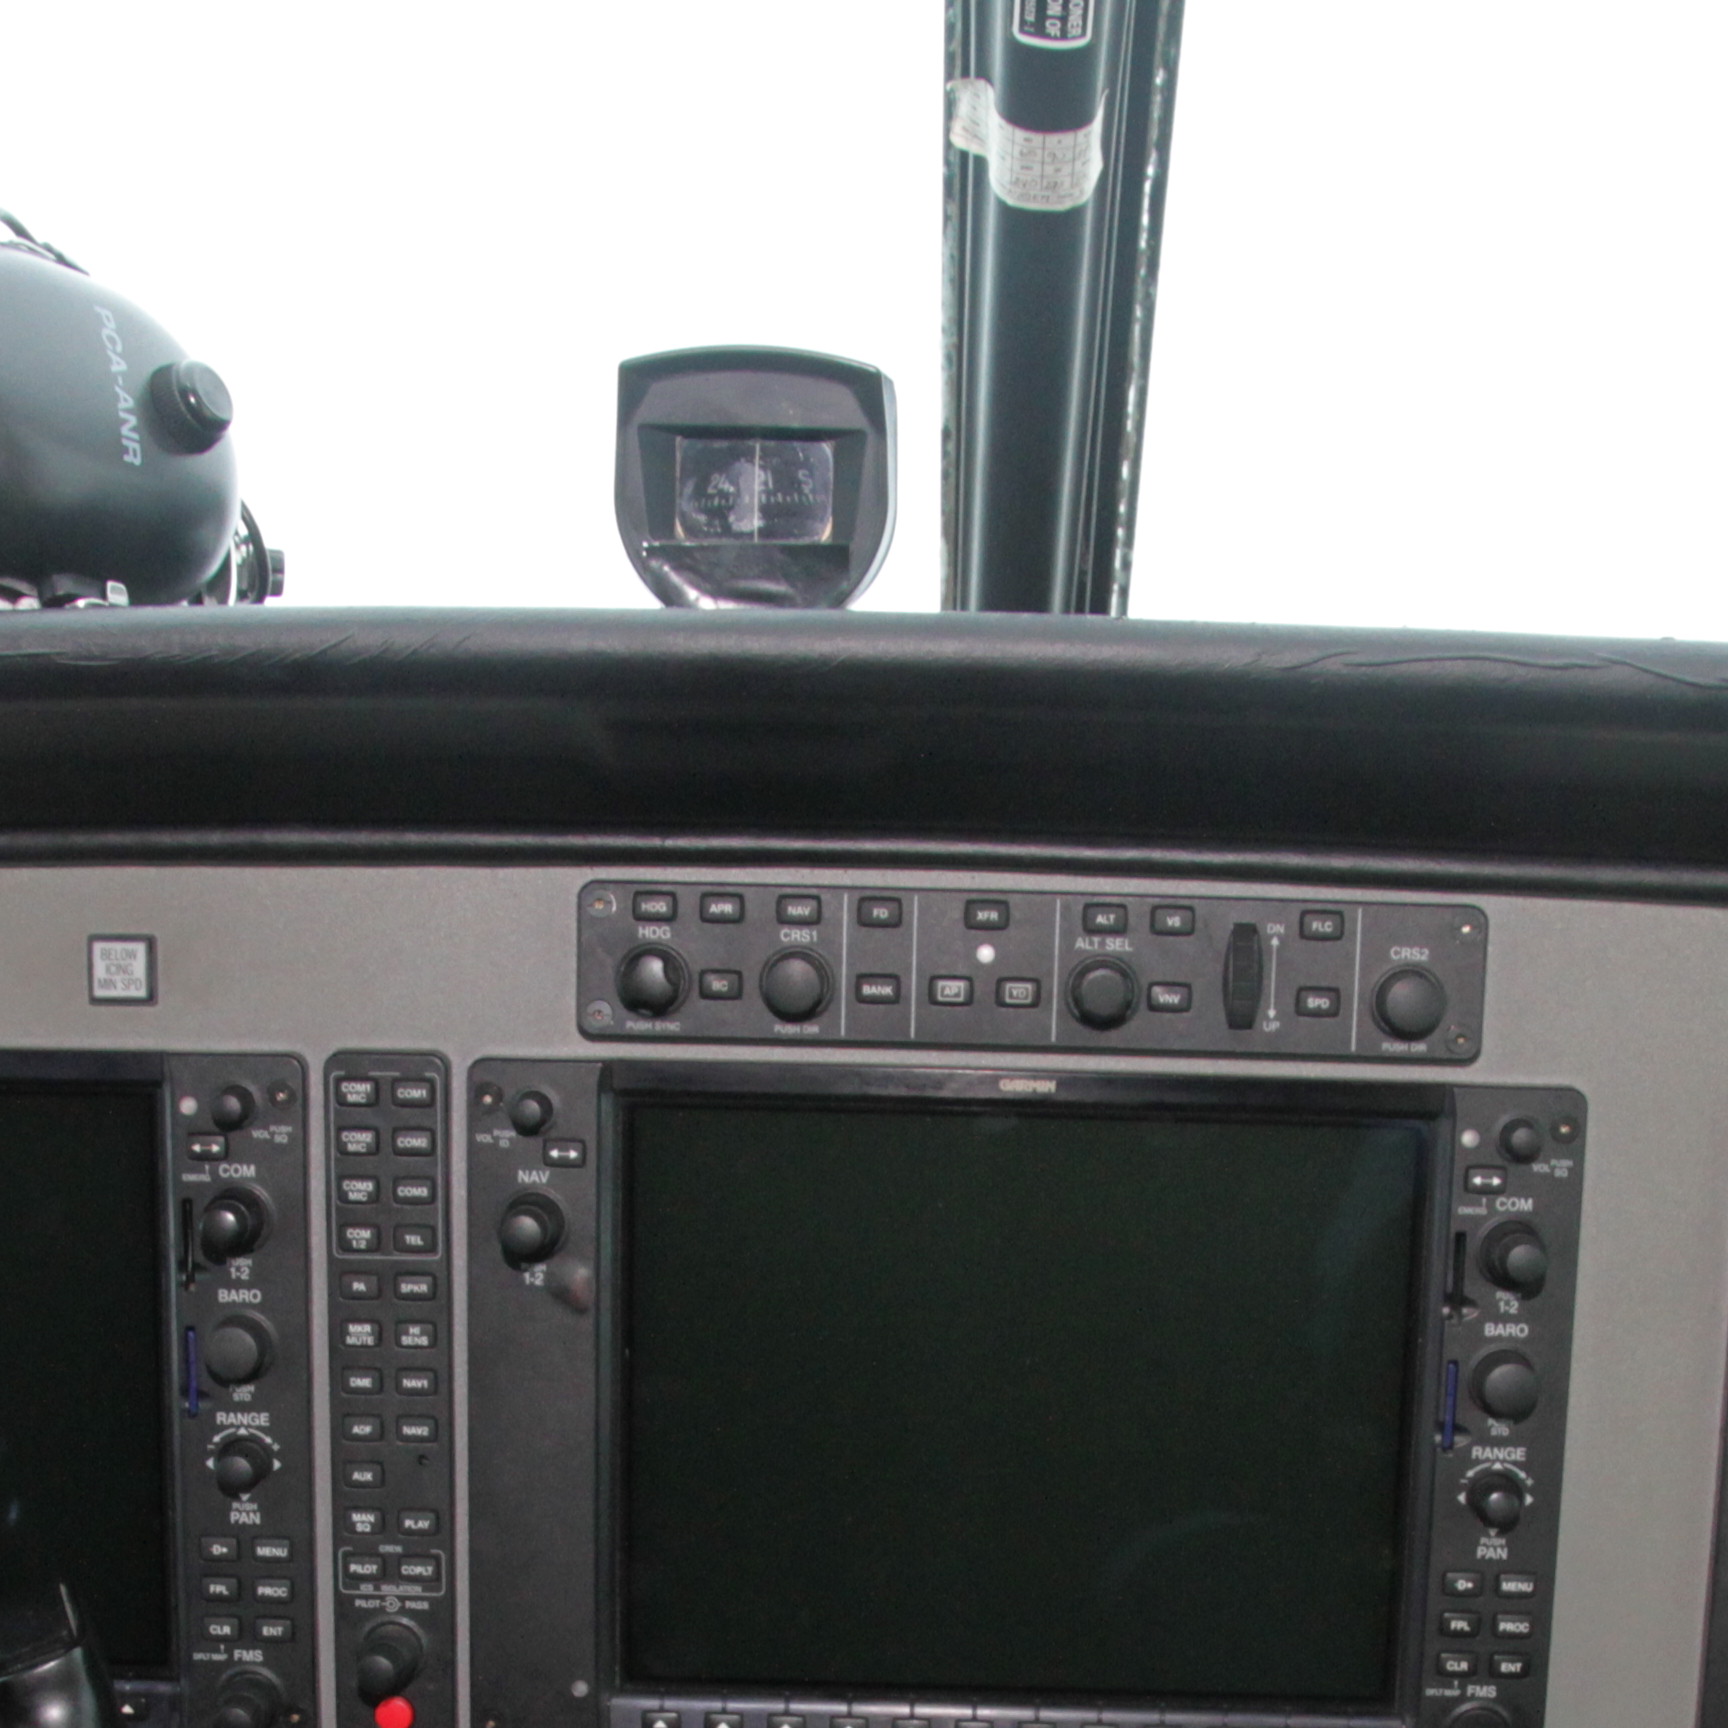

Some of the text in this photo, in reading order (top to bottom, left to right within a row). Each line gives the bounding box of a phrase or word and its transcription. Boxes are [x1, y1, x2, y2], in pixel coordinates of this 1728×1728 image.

[94, 305, 142, 466] PCA-ANR
[638, 926, 670, 939] HDG
[1267, 923, 1284, 934] DN
[781, 929, 817, 942] CRS1
[1075, 937, 1133, 951] ALT SEL
[1390, 947, 1428, 960] CRS2
[1263, 1021, 1279, 1032] UP
[999, 1079, 1056, 1092] GARMIN
[219, 1164, 255, 1178] COM
[518, 1171, 549, 1184] NAV
[1496, 1198, 1532, 1212] COM
[218, 1290, 261, 1303] BARO
[1484, 1323, 1528, 1337] BARO
[216, 1412, 270, 1427] RANGE
[1472, 1446, 1526, 1461] RANGE
[230, 1512, 260, 1525] PAN
[257, 1546, 287, 1557] MENU
[1477, 1546, 1508, 1560] PAN
[209, 1584, 228, 1595] FPL
[258, 1586, 287, 1597] PROC
[209, 1624, 230, 1635] CLR
[263, 1626, 282, 1637] ENT
[234, 1650, 263, 1662] FMS
